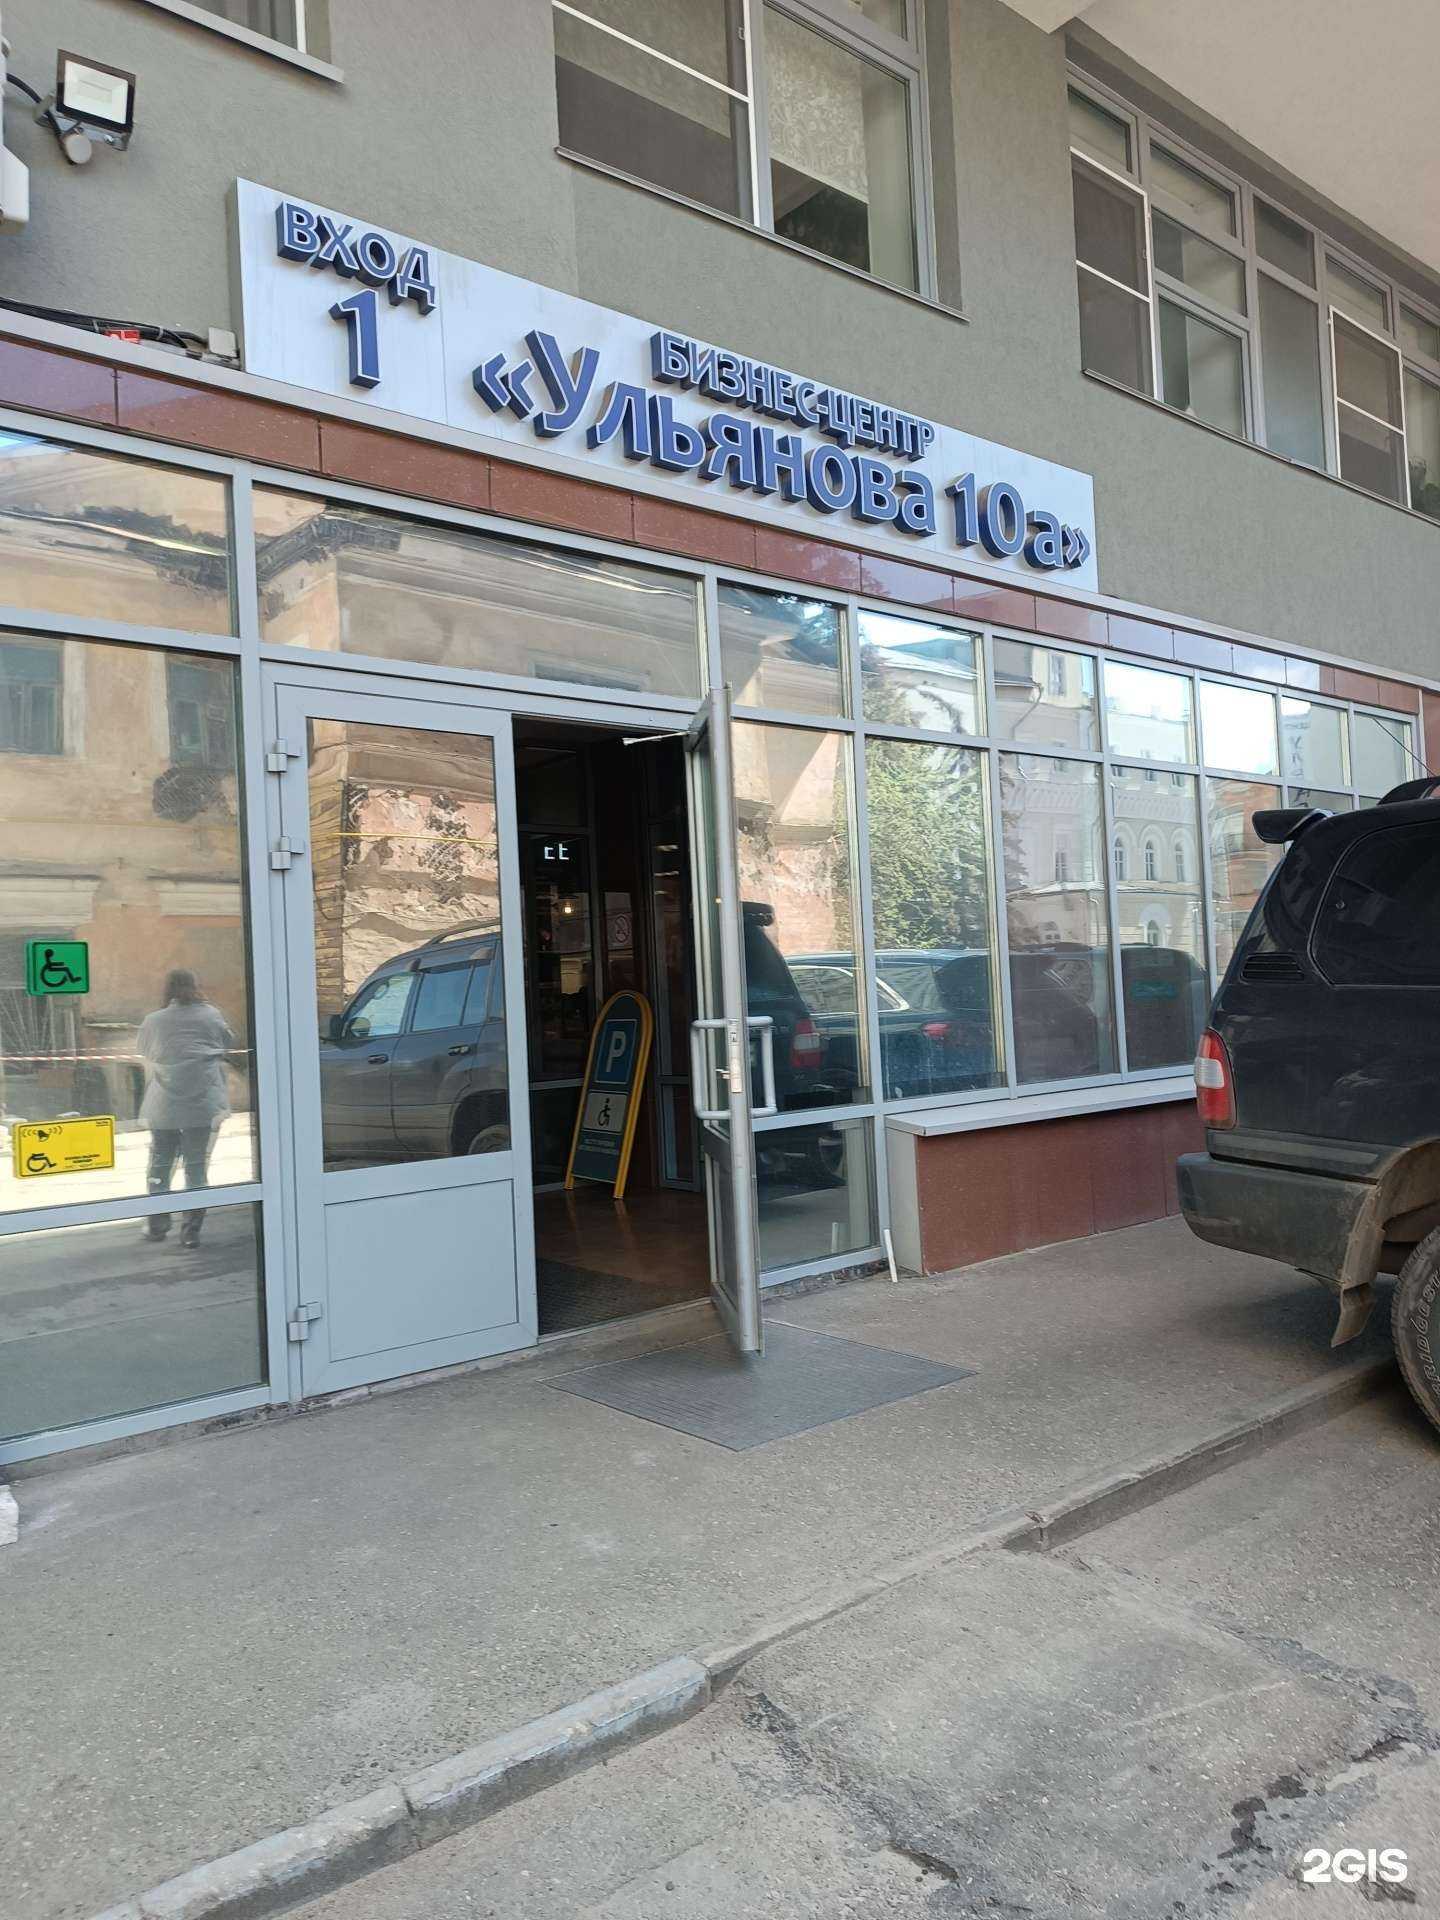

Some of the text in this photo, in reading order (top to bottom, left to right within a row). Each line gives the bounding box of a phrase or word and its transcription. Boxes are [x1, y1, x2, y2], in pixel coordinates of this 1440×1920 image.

[277, 201, 437, 315] ВХОД
[328, 288, 382, 389] 1
[650, 331, 935, 461] БИЗНЕС-ЦЕНТР
[605, 1030, 627, 1073] P
